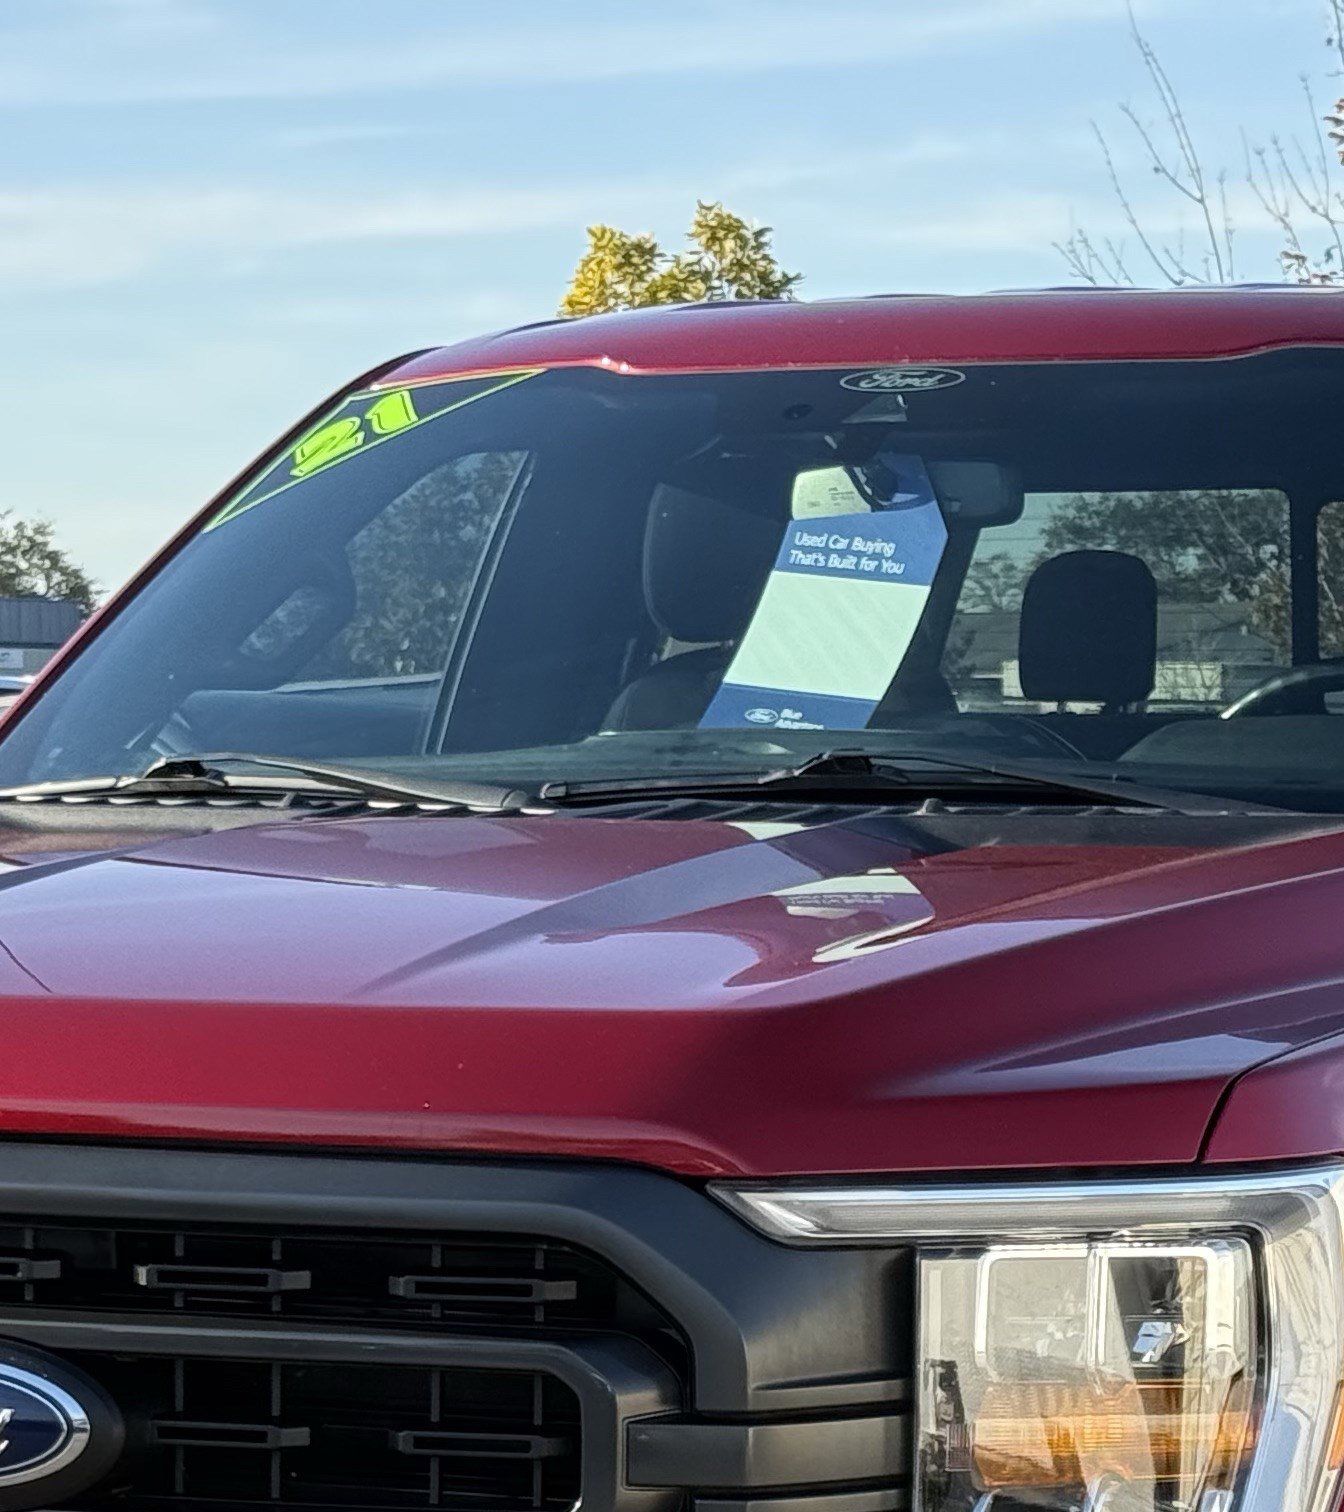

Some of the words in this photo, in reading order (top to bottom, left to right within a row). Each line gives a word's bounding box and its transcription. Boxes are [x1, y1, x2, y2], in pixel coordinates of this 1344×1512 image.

[859, 370, 947, 388] Ford
[289, 388, 420, 478] 21
[794, 531, 828, 548] Used
[828, 534, 850, 550] Car
[850, 536, 896, 558] Buying
[788, 549, 826, 567] That's
[827, 553, 857, 570] Built
[858, 556, 879, 572] for
[880, 558, 906, 575] You
